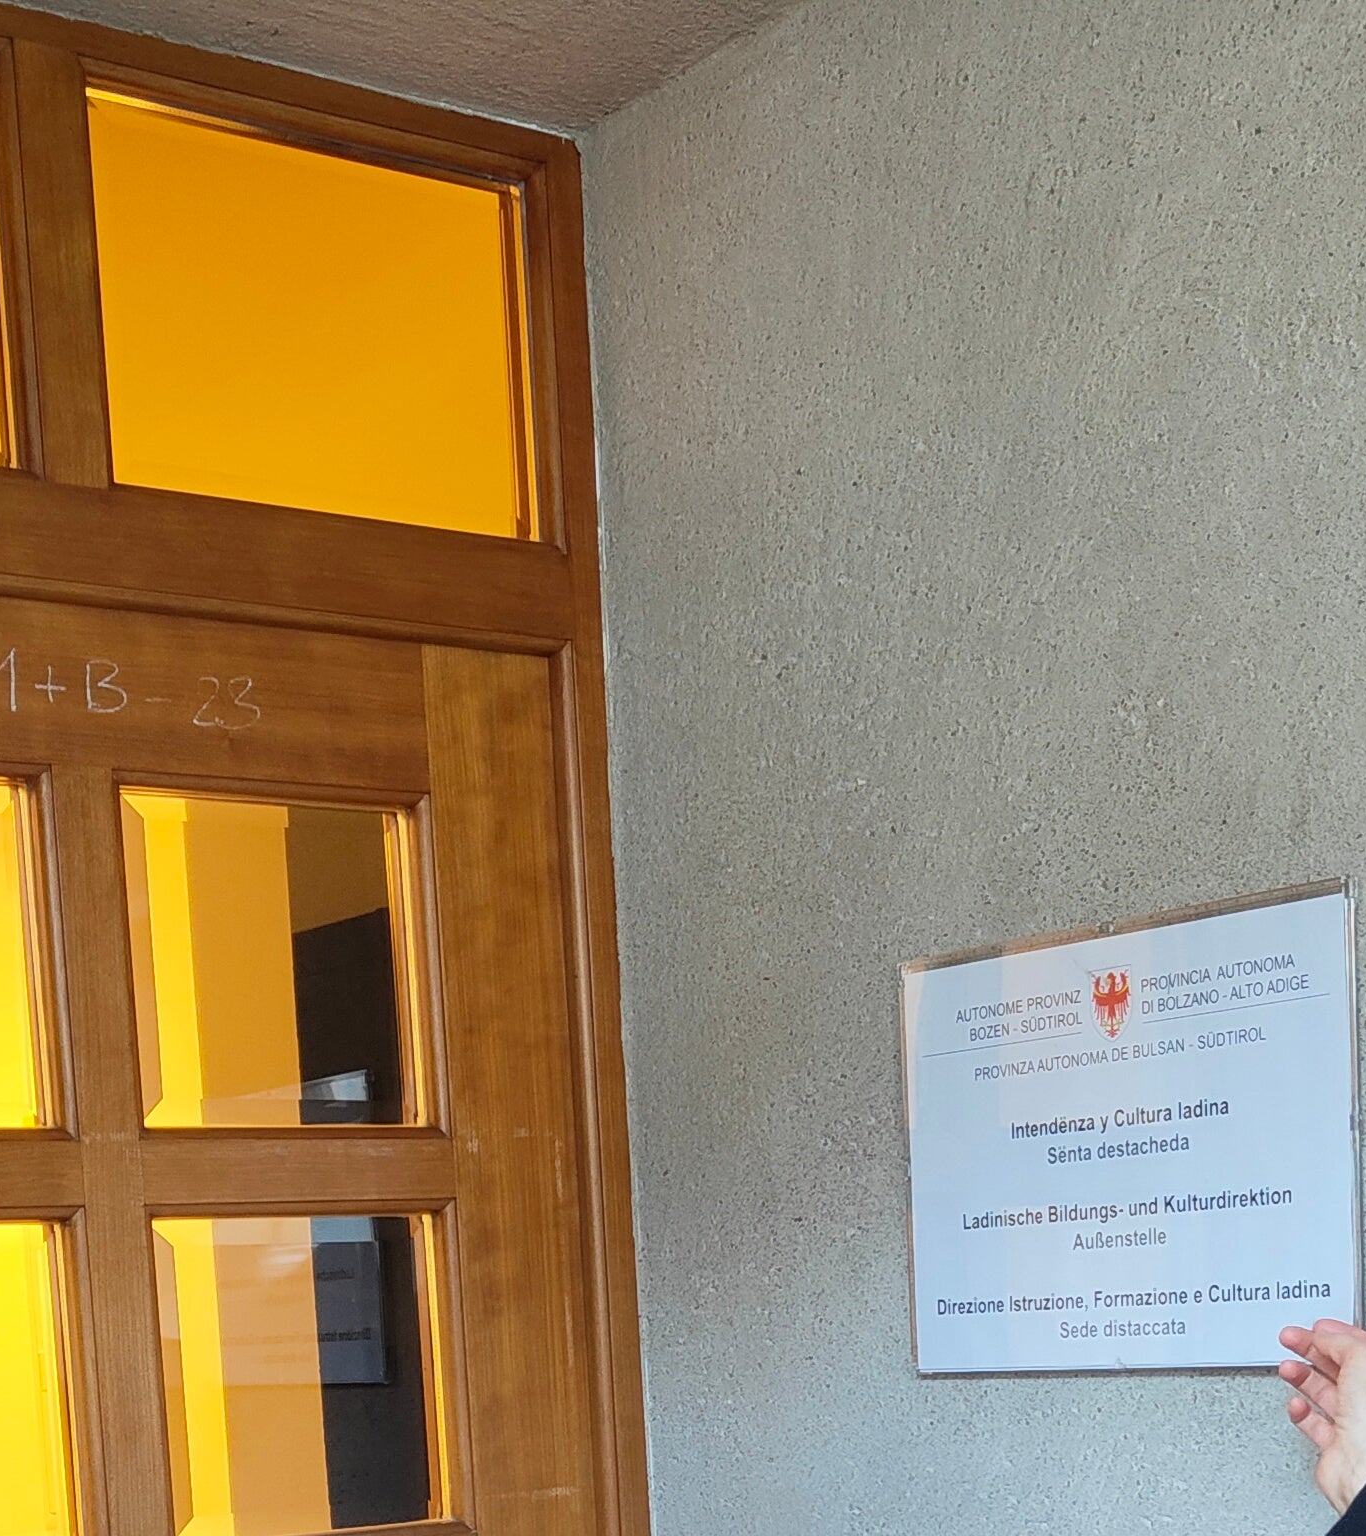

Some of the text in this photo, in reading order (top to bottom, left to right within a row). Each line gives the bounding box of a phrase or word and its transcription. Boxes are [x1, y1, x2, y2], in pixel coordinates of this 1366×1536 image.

[1141, 954, 1296, 993] PROVINCIA AUTONOMA
[956, 989, 1082, 1023] AUTONOME PROVINZ
[1141, 1000, 1154, 1015] DI
[1158, 989, 1220, 1013] BOLZANO
[1229, 982, 1263, 1001] ALTO
[1266, 974, 1310, 994] ADIGE
[969, 1023, 1010, 1042] BOZEN
[1020, 1011, 1083, 1034] SÜDTIROL
[974, 1060, 1035, 1082] PROVINZA
[1037, 1050, 1109, 1073] AUTONOMA
[1111, 1047, 1129, 1062] DE
[1133, 1038, 1185, 1059] BULSAN
[1197, 1026, 1267, 1050] SÜDTIROL
[1011, 1098, 1230, 1140] Intendënza y Cultura ladina
[1047, 1133, 1190, 1165] Sënta destacheda
[962, 1186, 1293, 1230] Ladinische Bildungs- und Kulturdirektion
[1072, 1227, 1168, 1251] Außenstelle
[937, 1279, 1332, 1315] Direzione Istruzione, Formazione e Cultura ladina
[1059, 1319, 1186, 1339] Sede distaccata
